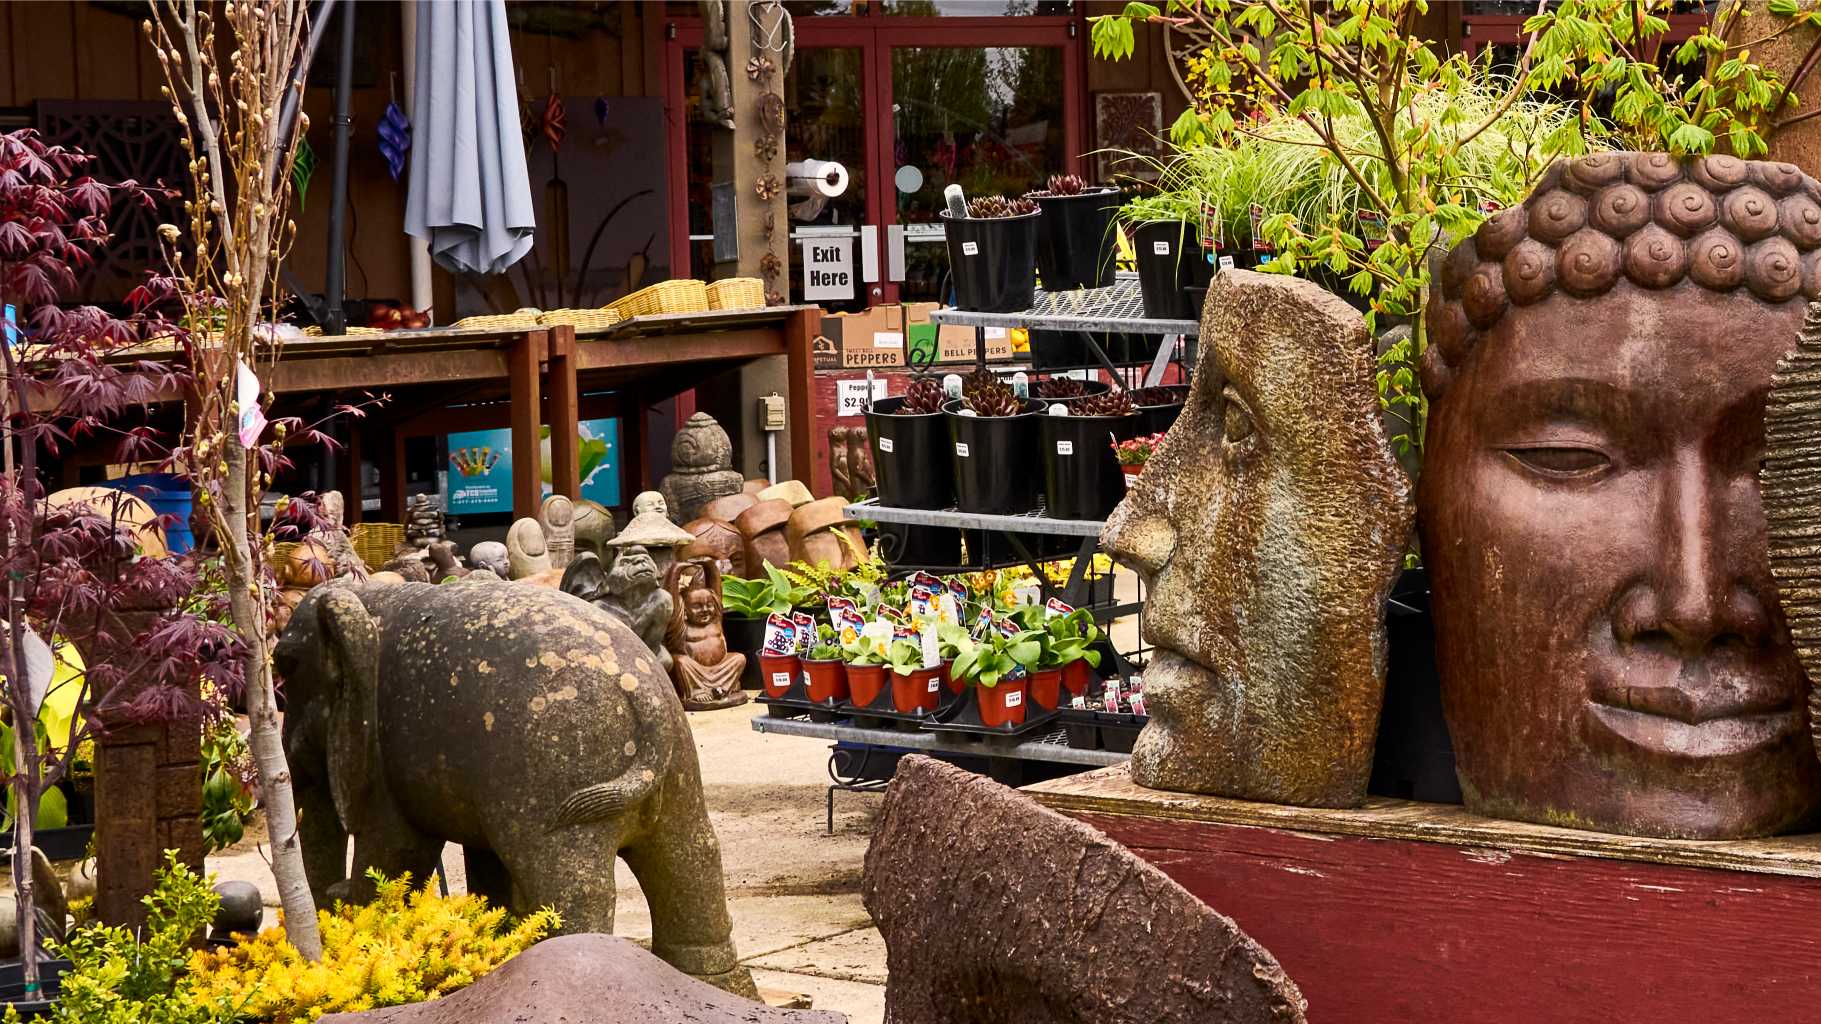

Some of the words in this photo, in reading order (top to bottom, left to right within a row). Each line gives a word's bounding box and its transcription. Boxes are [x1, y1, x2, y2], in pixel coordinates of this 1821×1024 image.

[812, 245, 841, 262] Exit
[810, 270, 848, 287] Here
[846, 353, 897, 365] PEPPERS
[944, 349, 965, 357] BELL
[844, 397, 868, 408] $2.9
